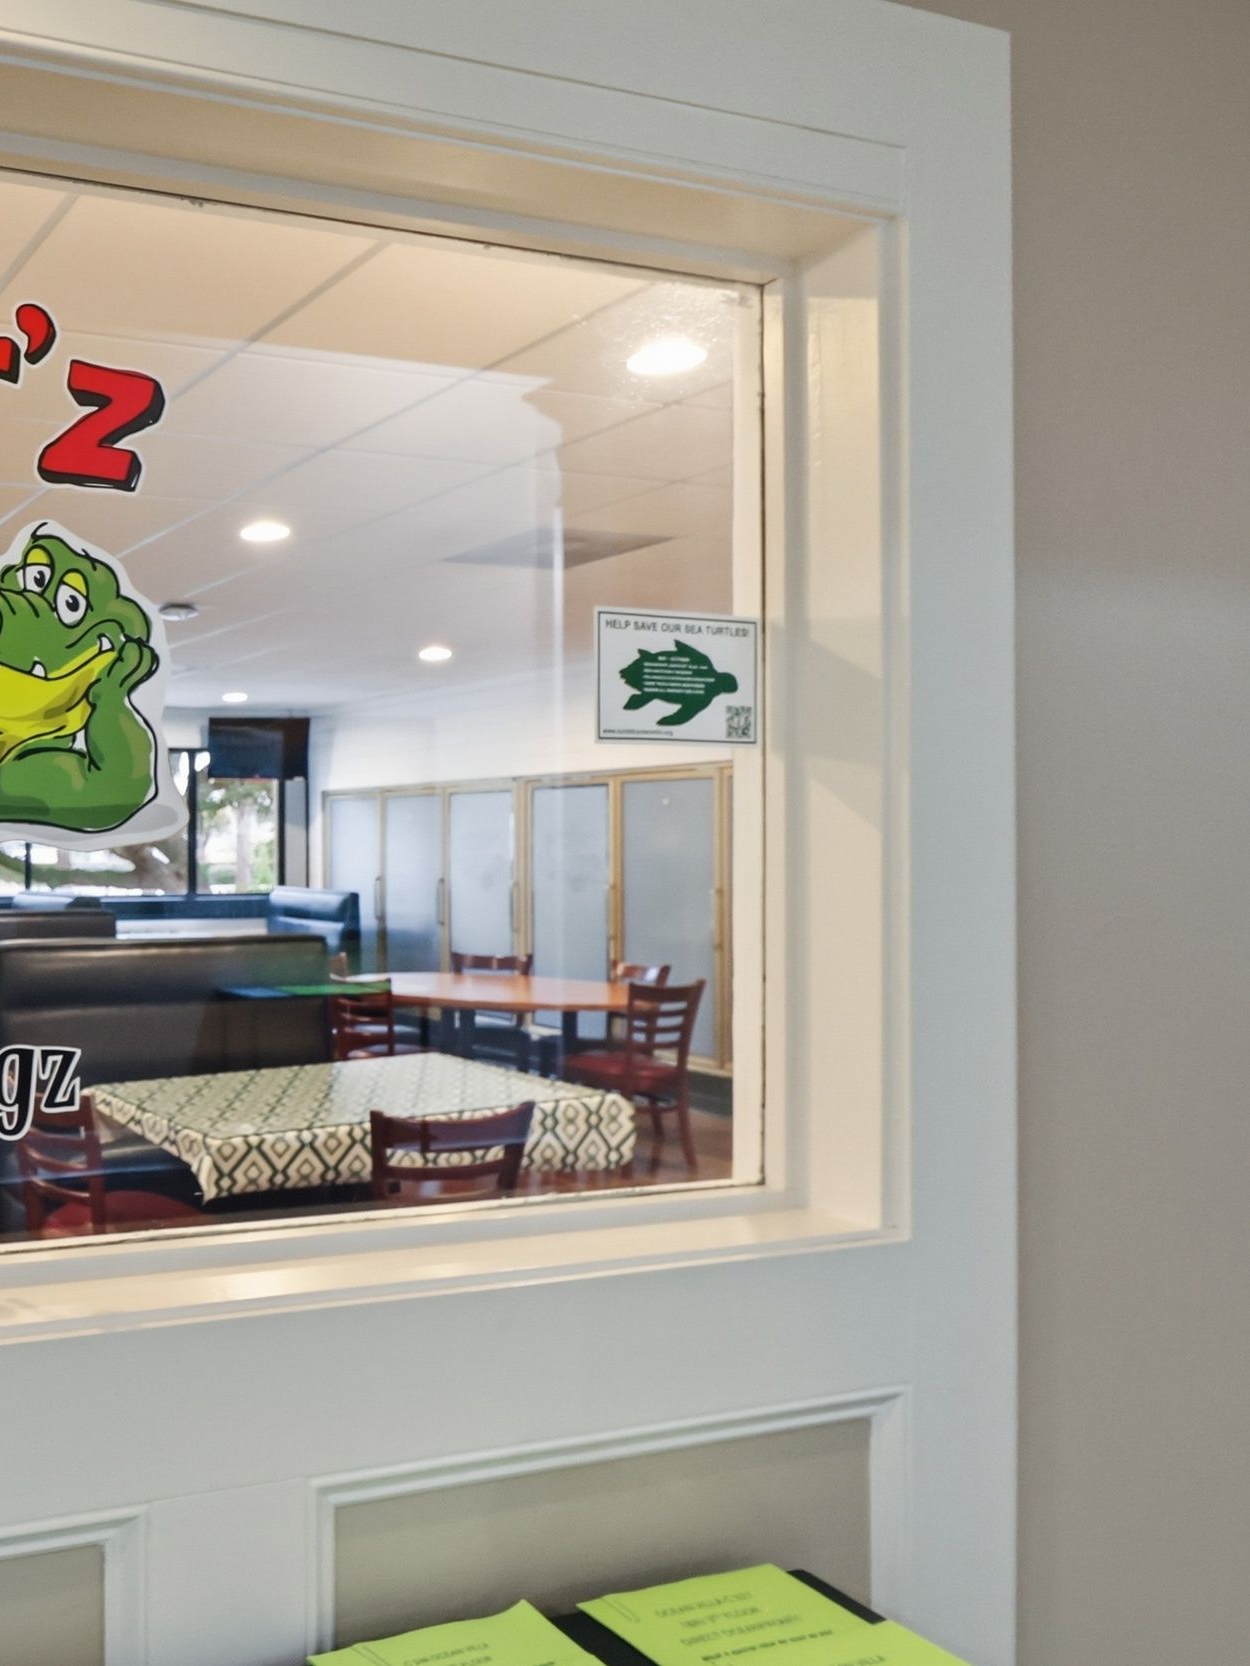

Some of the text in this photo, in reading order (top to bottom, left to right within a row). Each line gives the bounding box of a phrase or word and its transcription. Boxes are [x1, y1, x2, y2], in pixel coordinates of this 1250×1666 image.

[605, 618, 631, 630] HELP
[633, 621, 659, 632] SAVE
[661, 622, 682, 633] OUR
[684, 624, 703, 634] SEA
